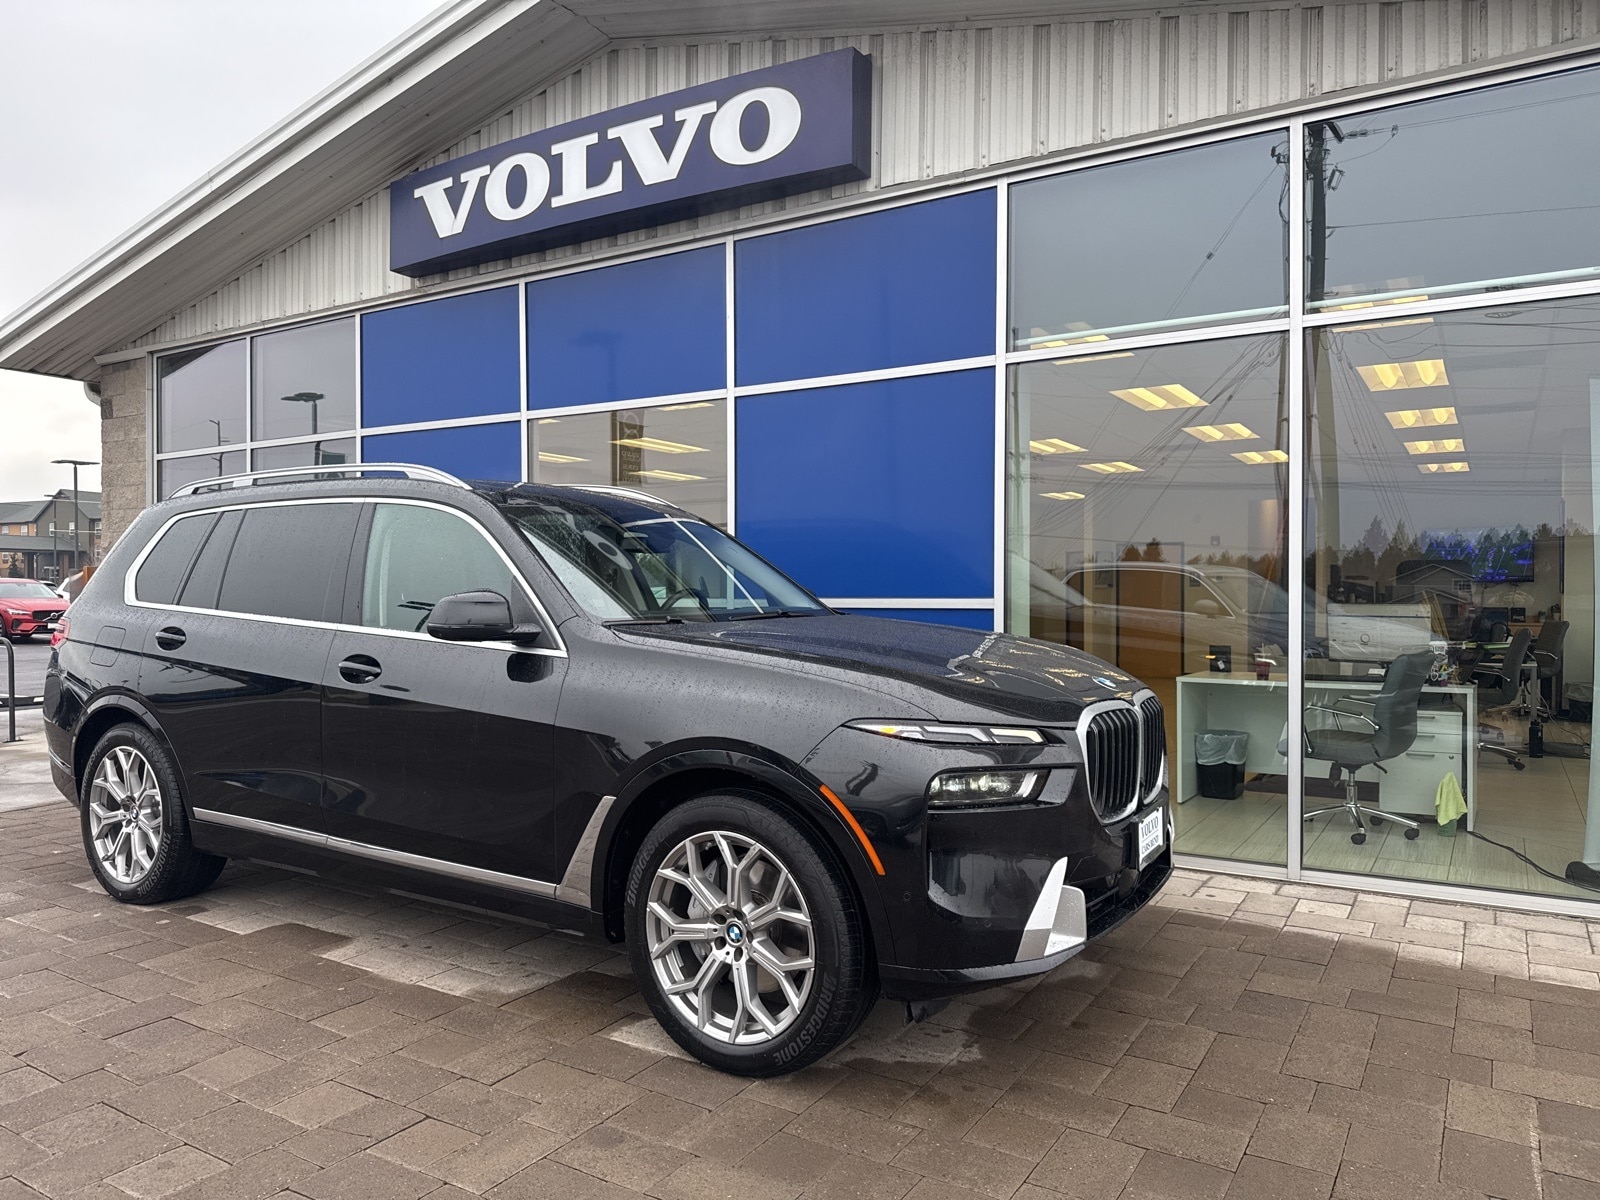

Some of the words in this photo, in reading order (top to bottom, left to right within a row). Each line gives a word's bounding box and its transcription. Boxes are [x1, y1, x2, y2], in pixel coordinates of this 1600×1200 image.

[414, 86, 802, 239] VOLVO
[136, 832, 172, 897] BRIDGESTONE
[626, 818, 680, 907] BRIDGESTONE
[1141, 816, 1159, 839] VOLVO
[773, 972, 838, 1066] BRIDGESTONE
